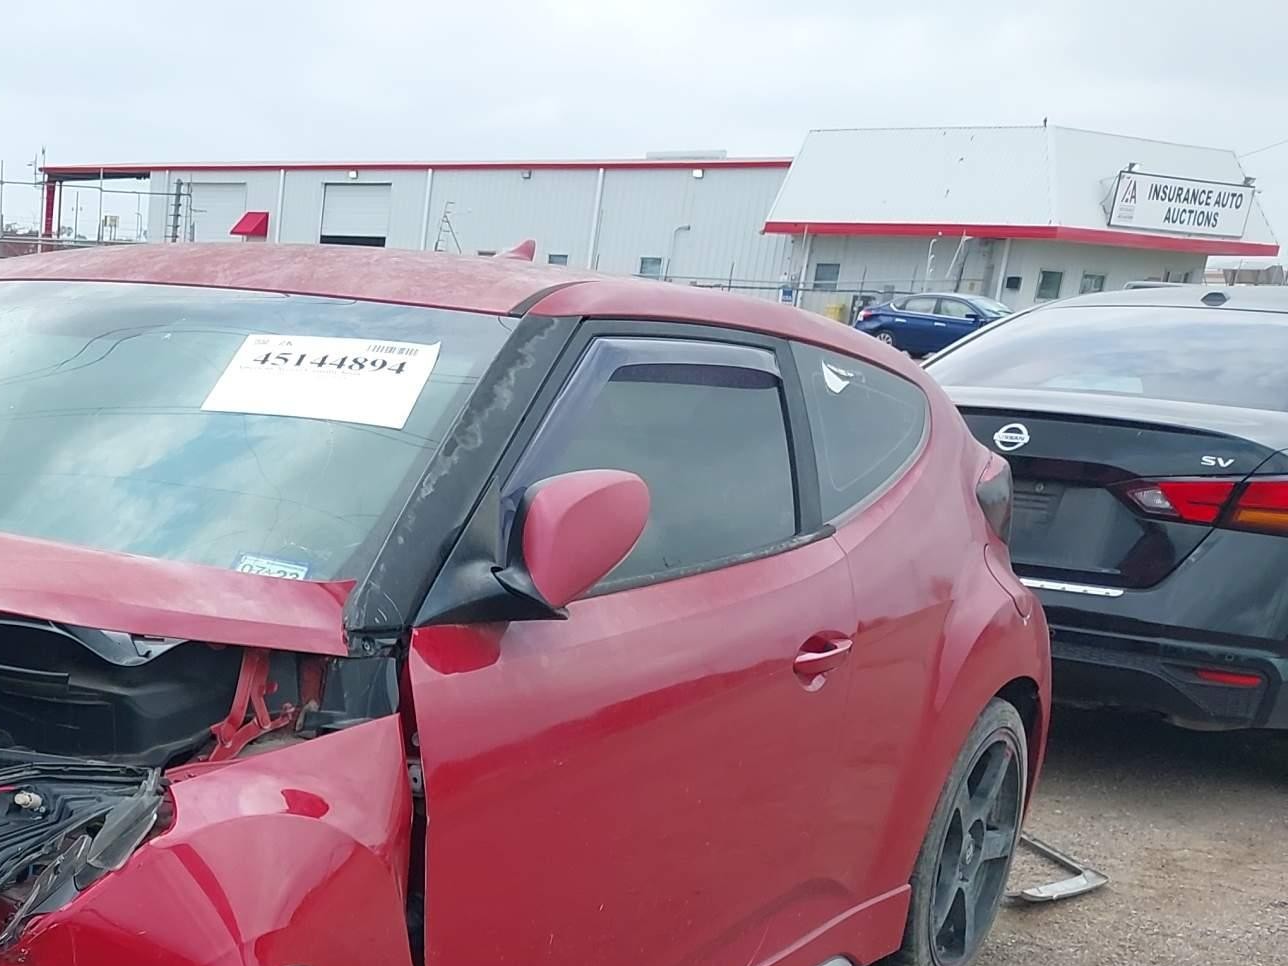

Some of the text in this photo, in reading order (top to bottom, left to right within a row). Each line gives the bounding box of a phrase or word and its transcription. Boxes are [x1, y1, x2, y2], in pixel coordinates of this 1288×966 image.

[1147, 183, 1244, 210] INSURANCE AUTO
[1163, 207, 1219, 228] AUCTIONS
[252, 351, 408, 375] 45144894
[1200, 455, 1235, 468] SV
